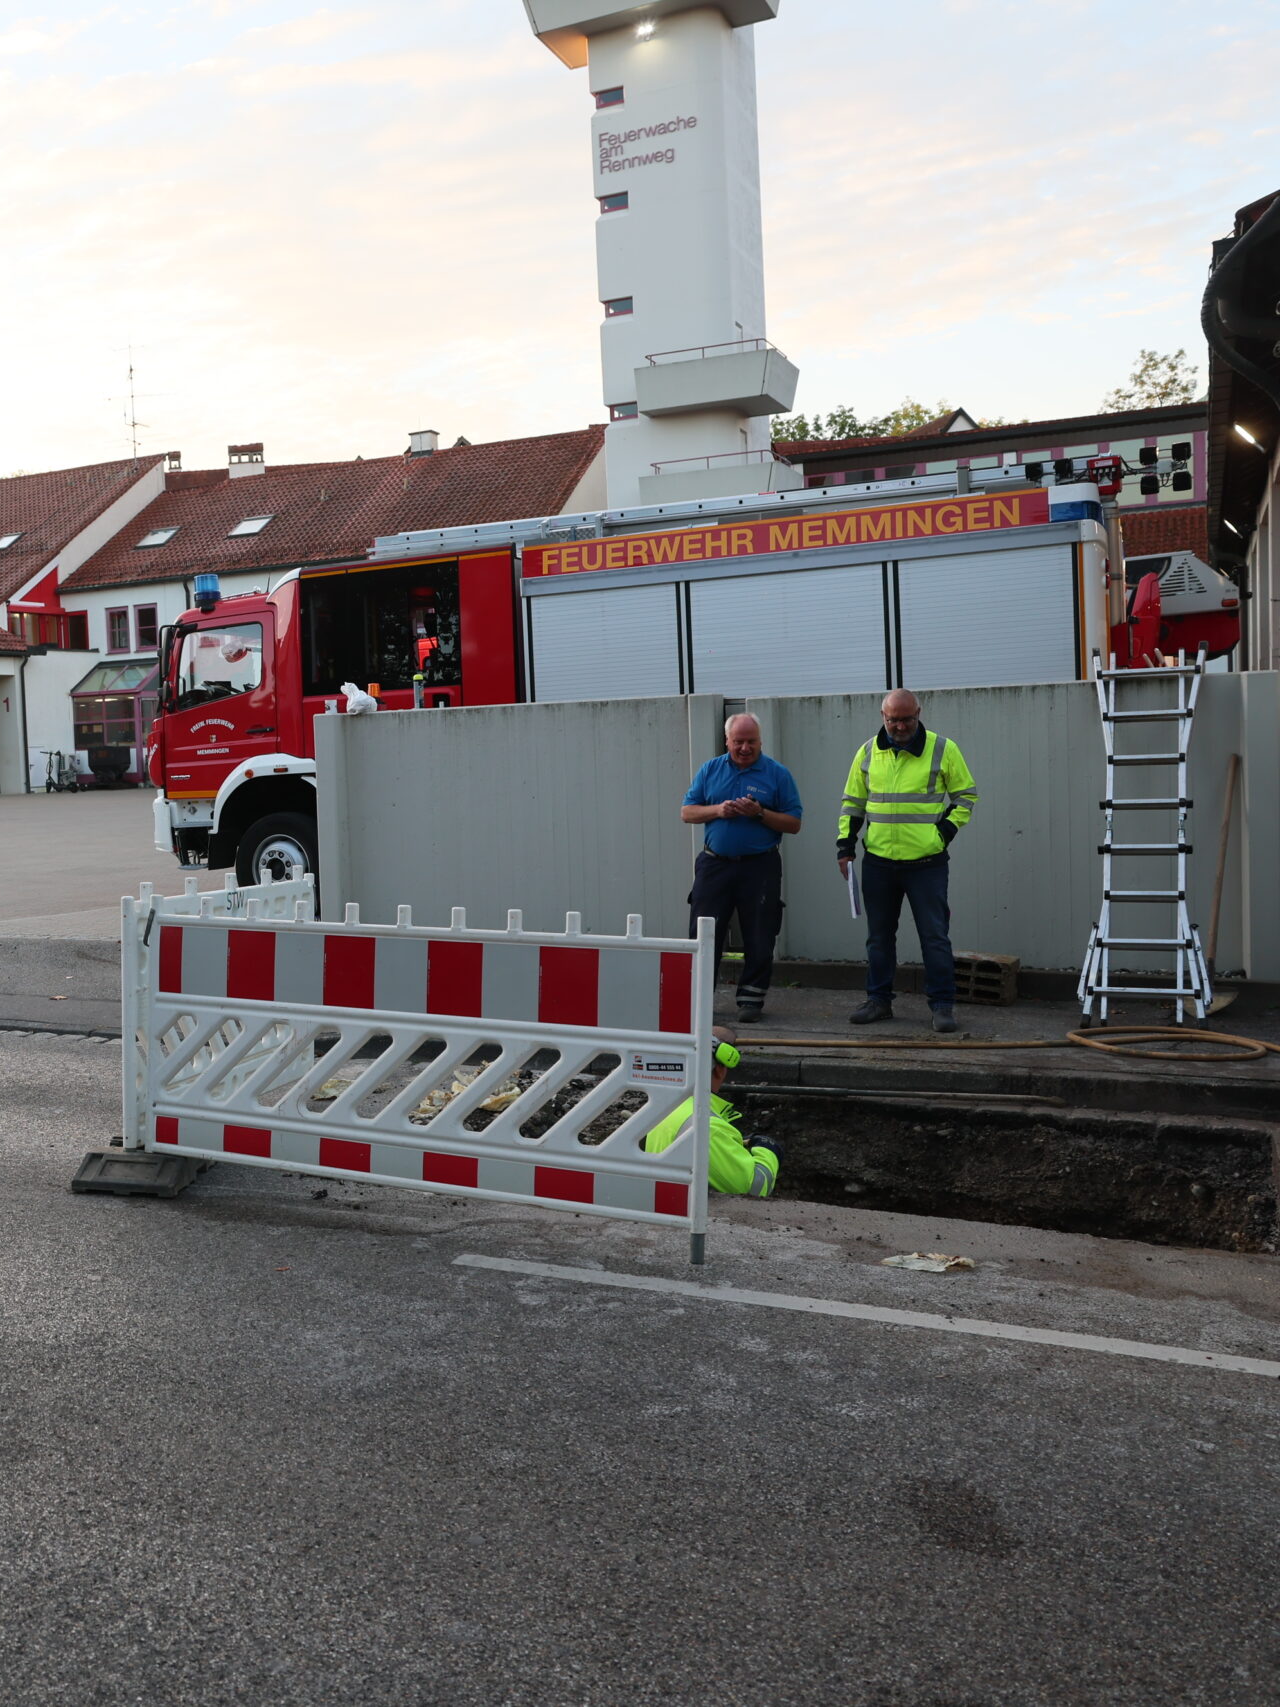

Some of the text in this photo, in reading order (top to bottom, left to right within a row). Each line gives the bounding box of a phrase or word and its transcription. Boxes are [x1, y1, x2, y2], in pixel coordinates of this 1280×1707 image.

[598, 115, 697, 148] Feuerwache
[599, 144, 624, 159] am
[599, 146, 676, 175] Rennweg
[541, 497, 1020, 576] FEUERWEHR MEMMINGEN
[2, 697, 10, 712] 1
[226, 891, 245, 911] STW
